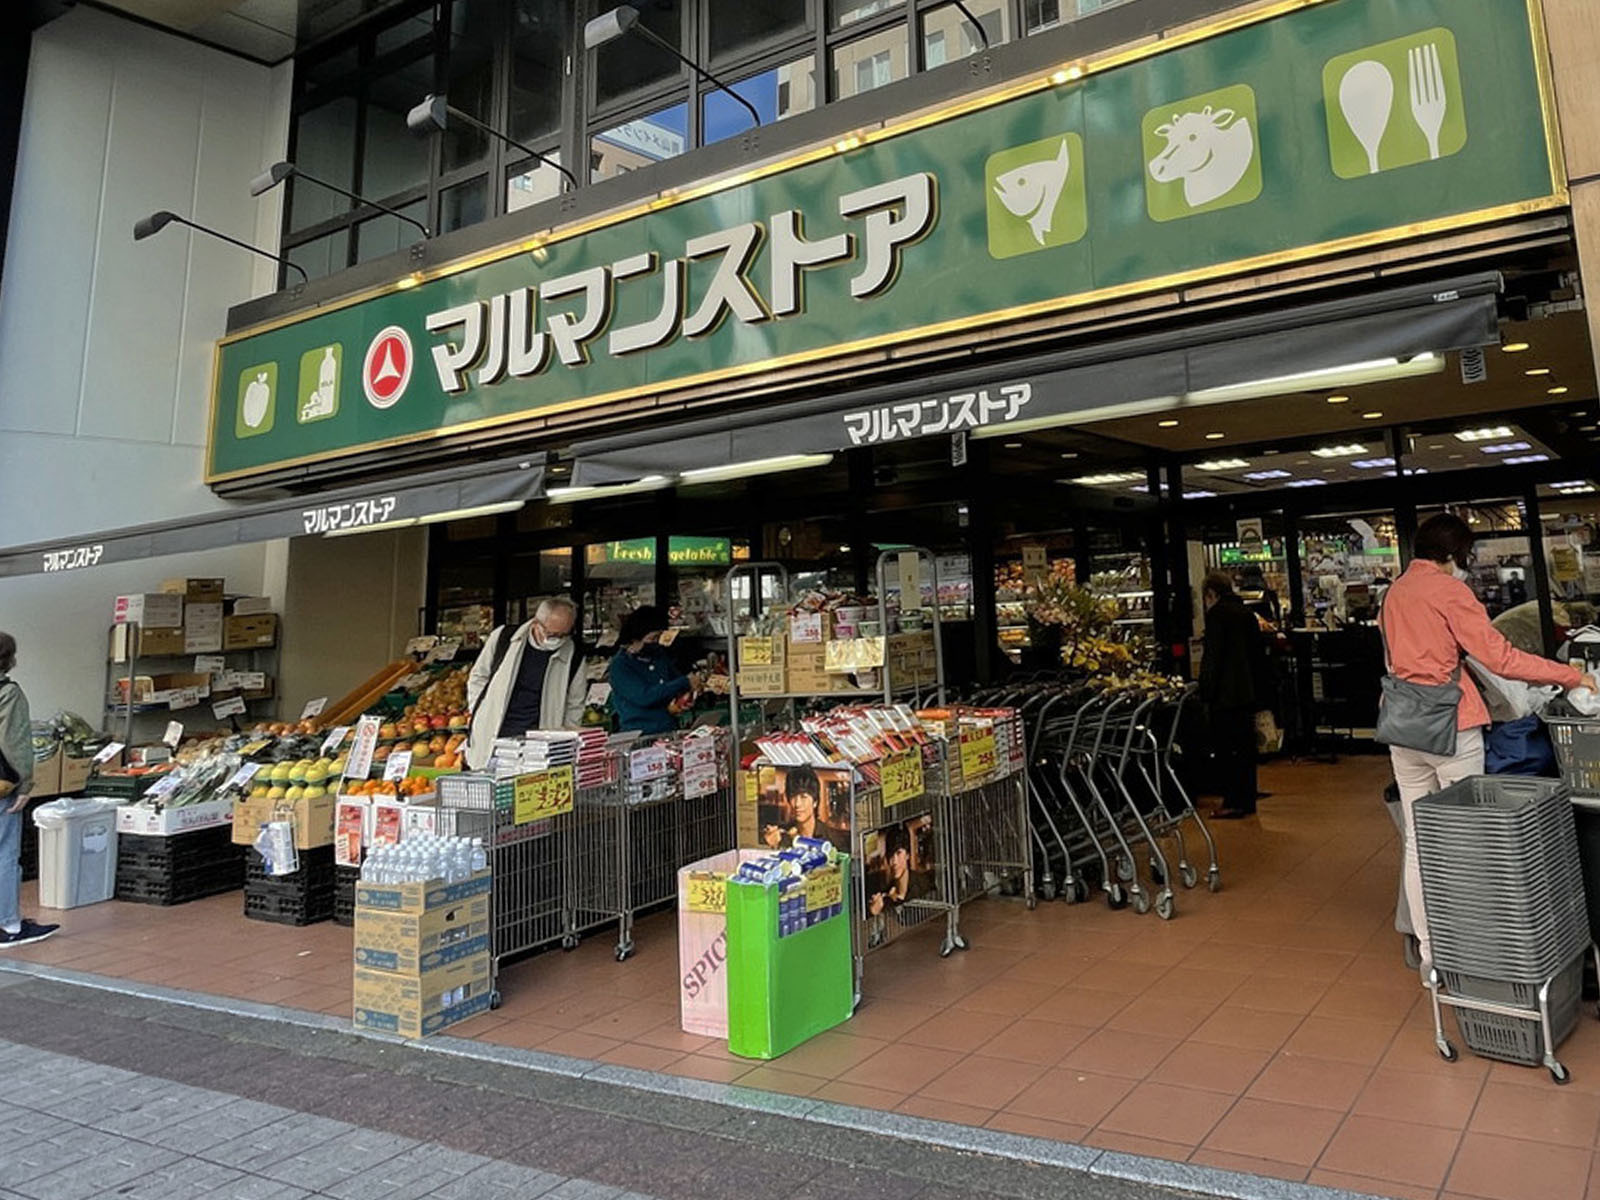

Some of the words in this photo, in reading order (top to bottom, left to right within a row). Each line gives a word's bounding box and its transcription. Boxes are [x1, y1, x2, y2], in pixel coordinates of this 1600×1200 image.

[425, 173, 934, 393] マルマンストア
[843, 383, 1032, 445] マルマンストア
[303, 497, 396, 534] マルマンストア
[43, 545, 103, 572] マルマンストア
[683, 931, 729, 998] SPIC
